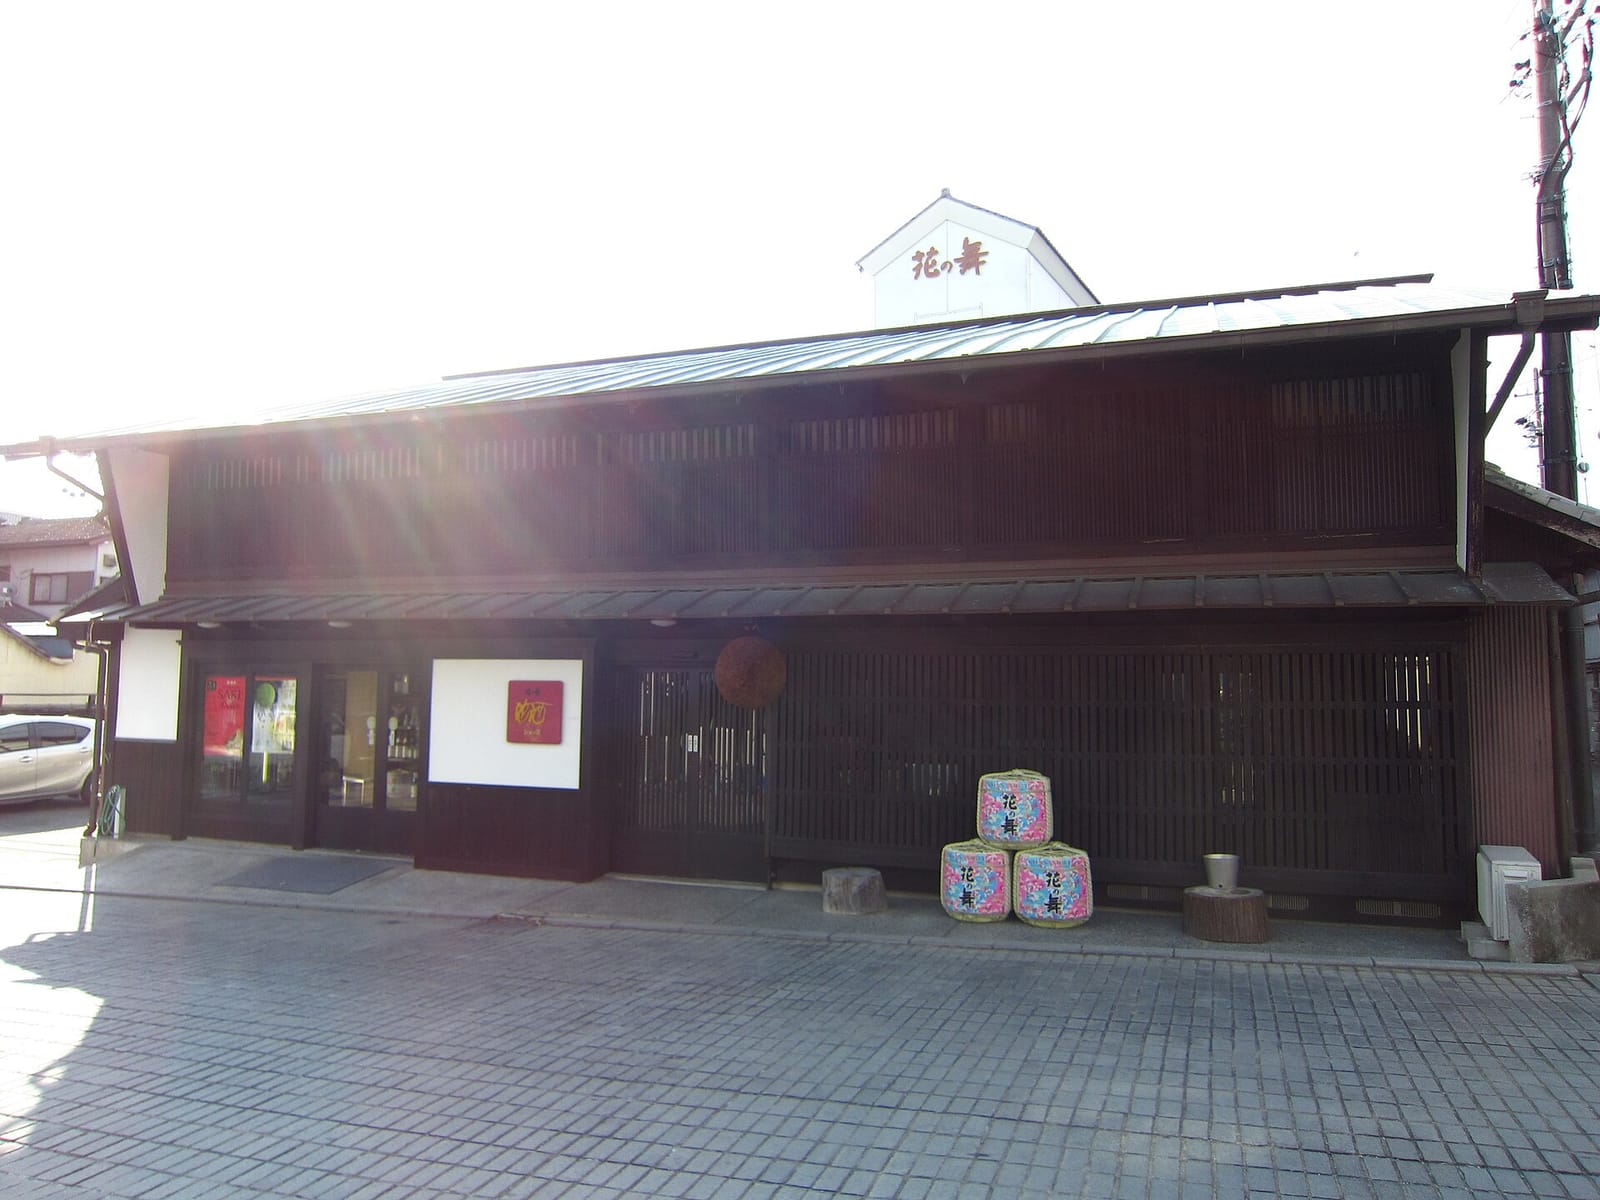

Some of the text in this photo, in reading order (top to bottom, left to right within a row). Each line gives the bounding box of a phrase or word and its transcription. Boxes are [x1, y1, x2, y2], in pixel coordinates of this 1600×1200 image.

[912, 236, 989, 280] 花の舞
[1001, 793, 1018, 837] 花の舞
[959, 866, 976, 909] 花の舞
[1044, 871, 1063, 915] 花の舞
